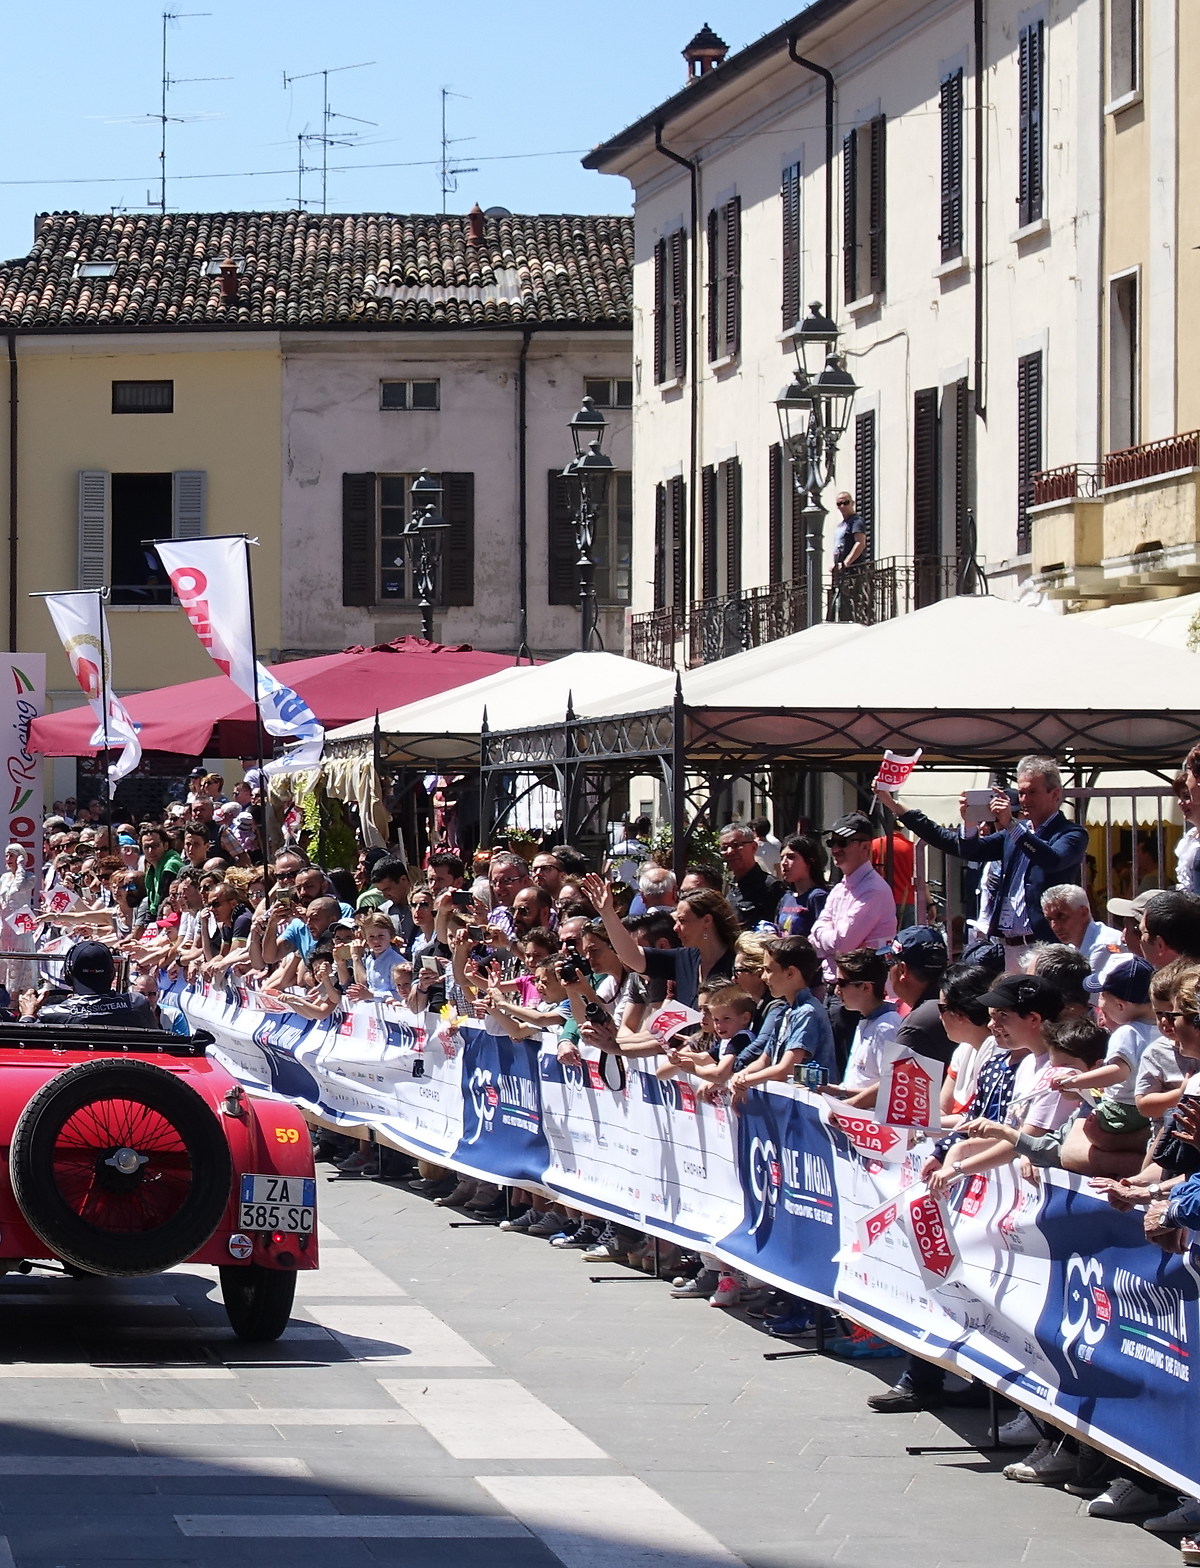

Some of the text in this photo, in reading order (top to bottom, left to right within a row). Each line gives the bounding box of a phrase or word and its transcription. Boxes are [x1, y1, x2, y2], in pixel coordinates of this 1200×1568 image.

[71, 1001, 128, 1015] CLASSICTEAM
[892, 1071, 910, 1121] 1000
[911, 1077, 927, 1127] MIGLIA
[275, 1128, 299, 1143] 59
[266, 1179, 290, 1202] ZA
[242, 1205, 312, 1231] 385 SC
[912, 1207, 934, 1258] 1000
